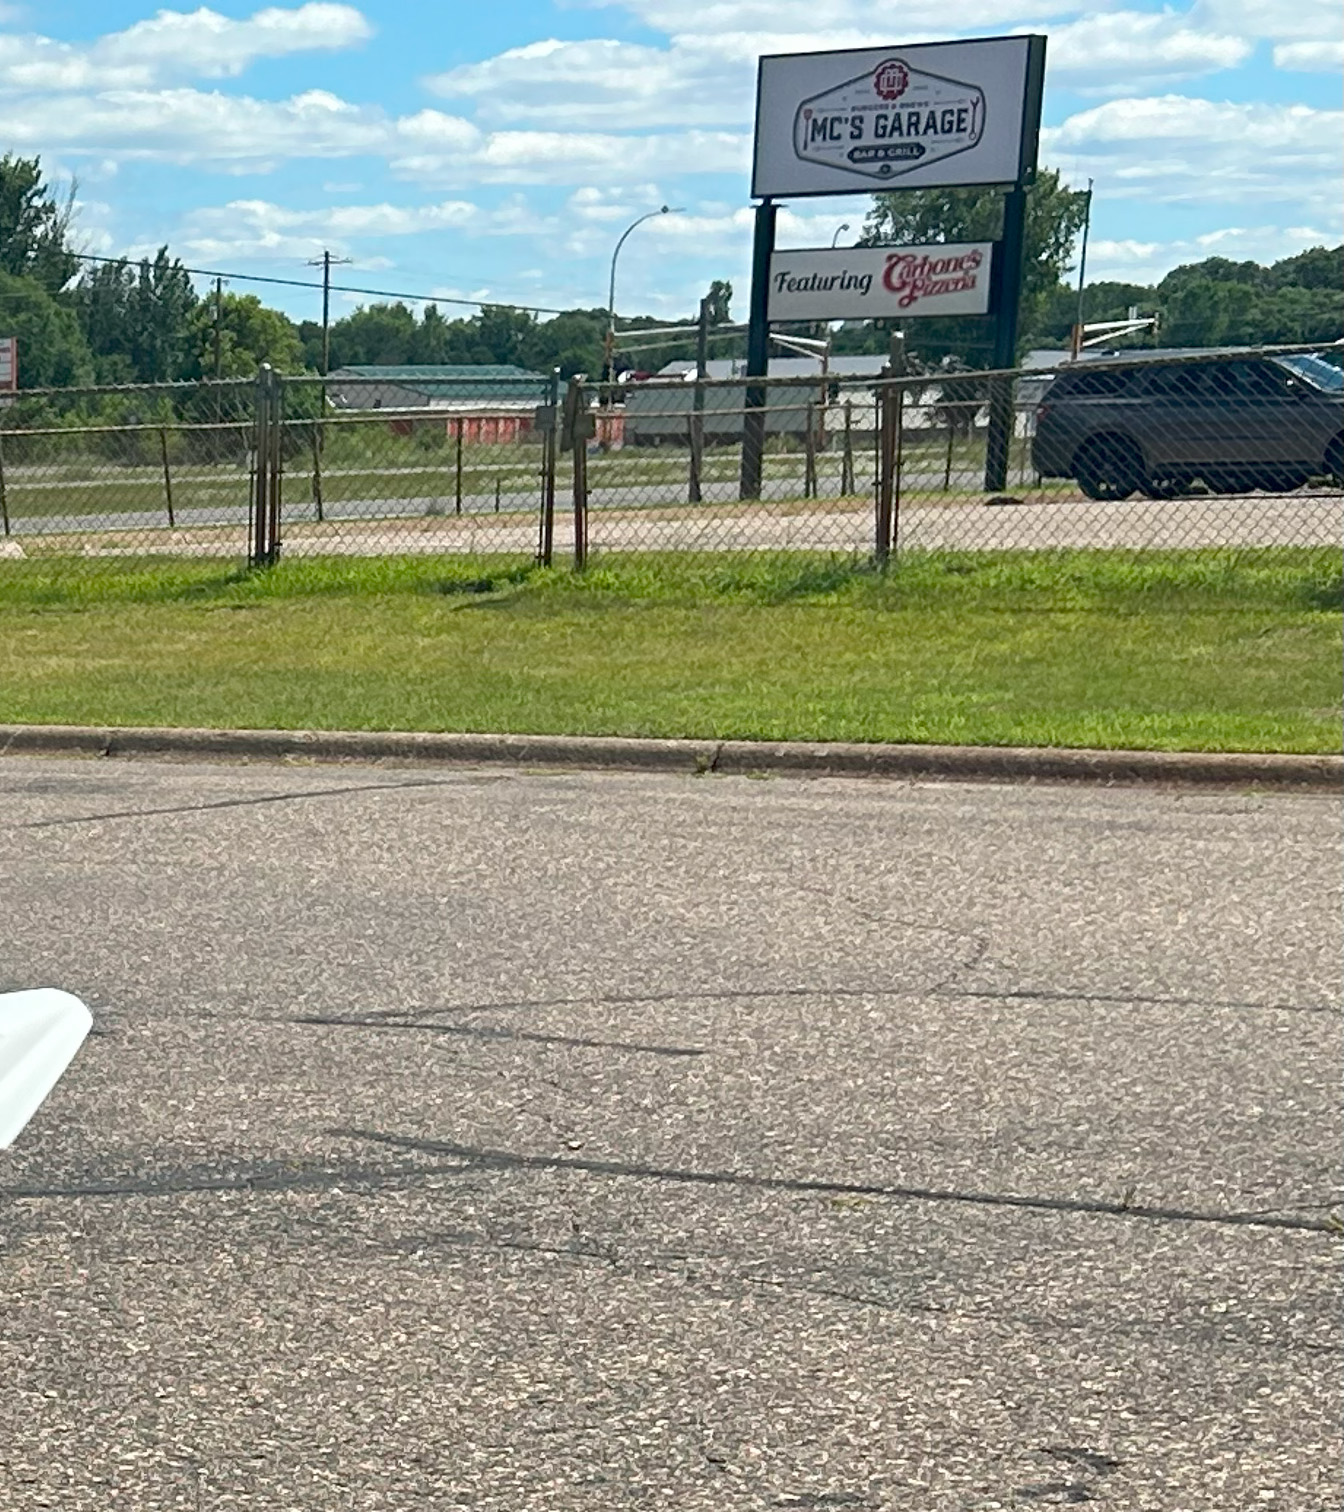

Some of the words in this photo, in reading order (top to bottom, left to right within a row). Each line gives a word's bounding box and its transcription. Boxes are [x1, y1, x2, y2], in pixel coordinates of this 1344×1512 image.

[811, 114, 864, 142] MC'S
[874, 108, 969, 138] GARAGE
[773, 270, 873, 296] Featuring
